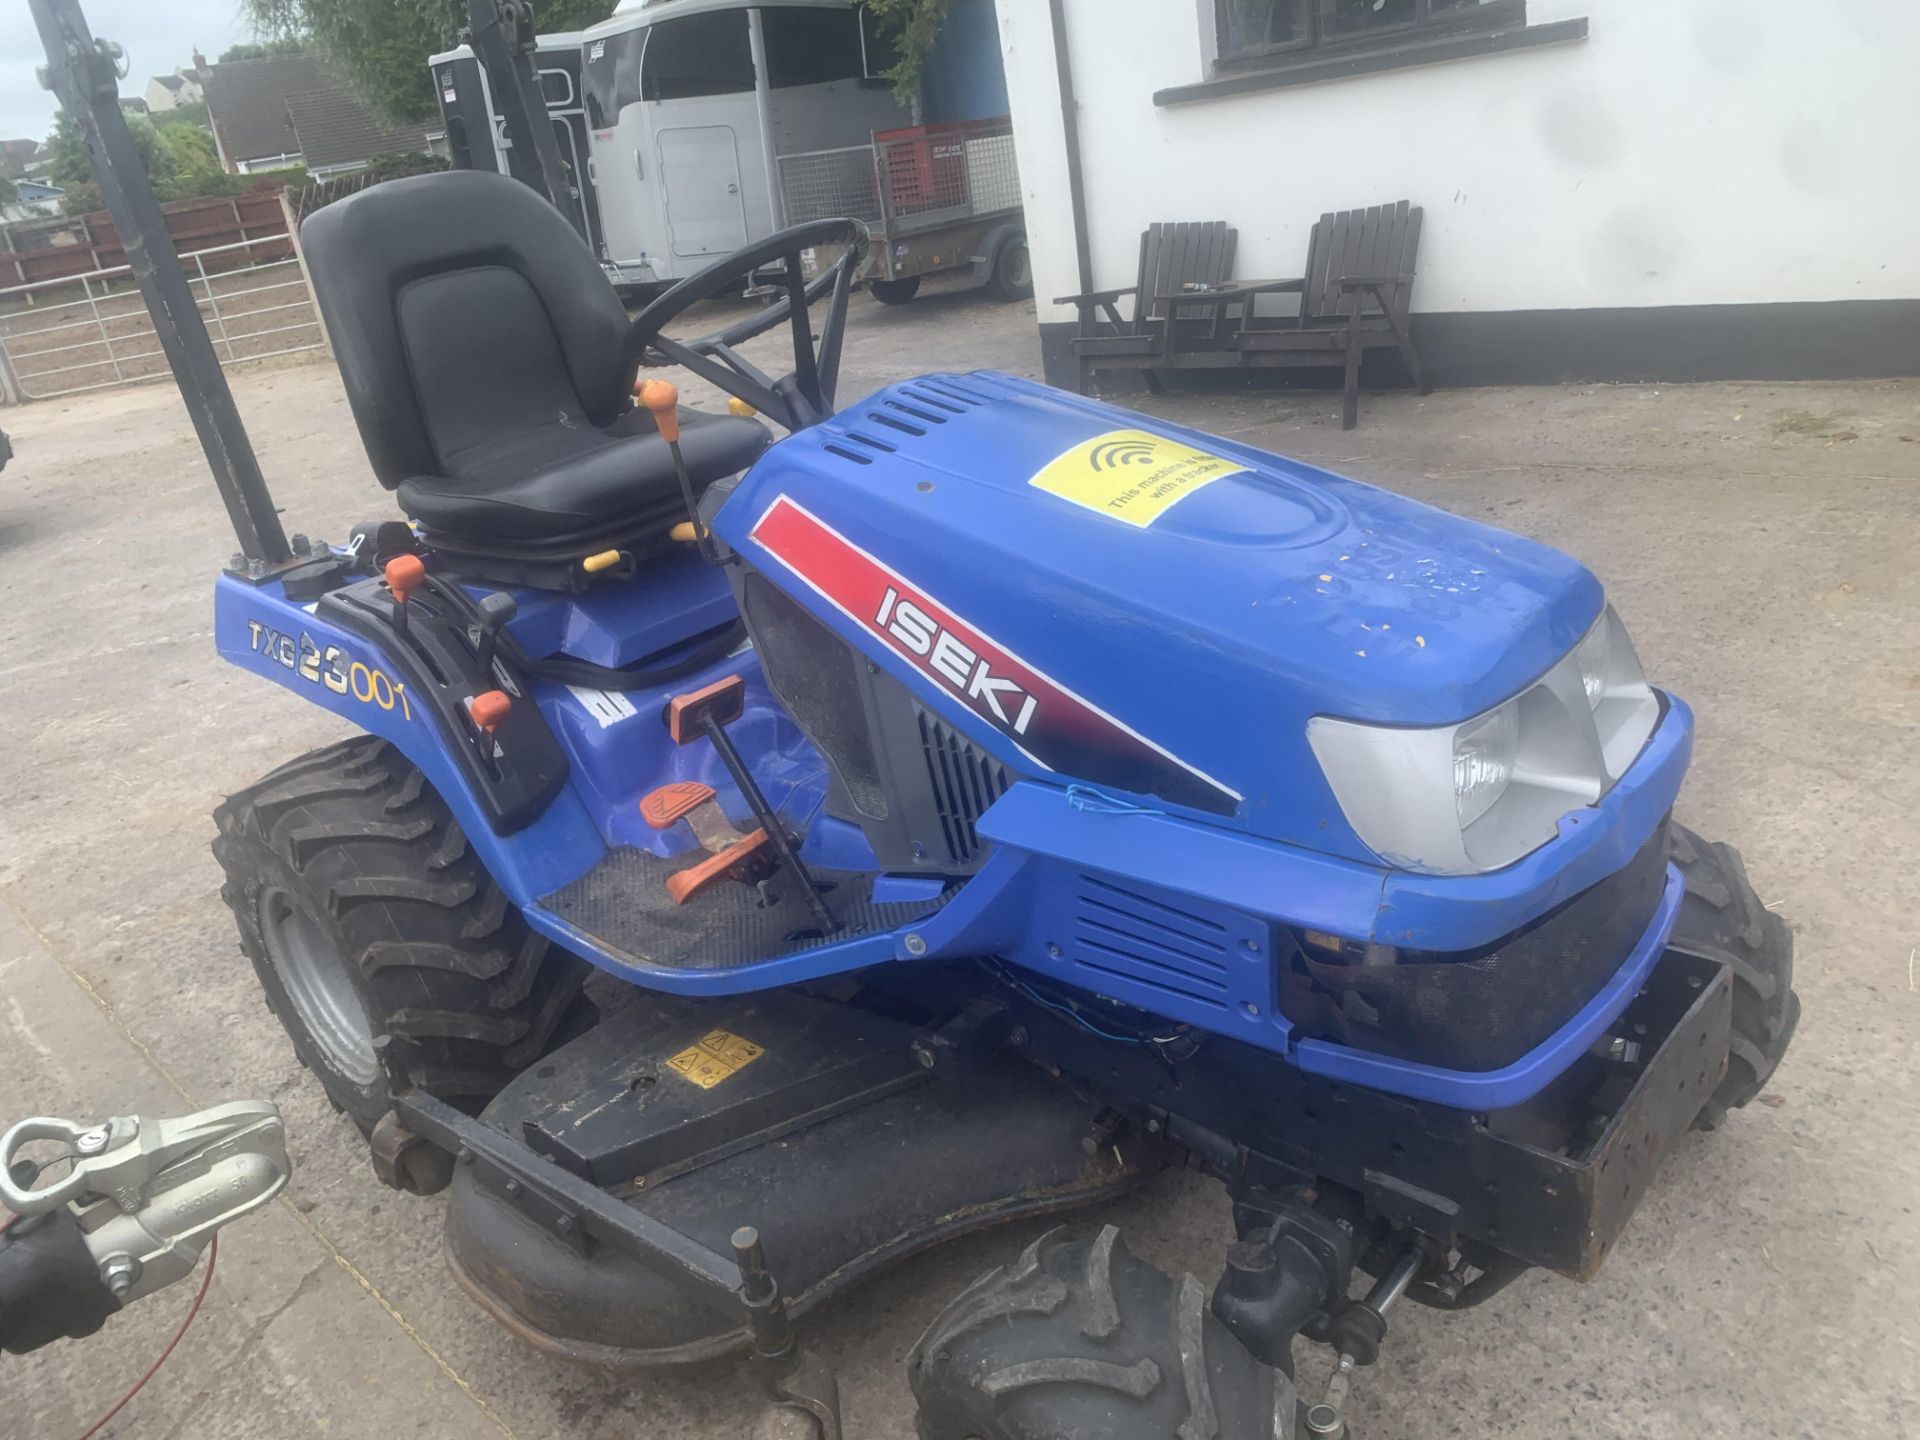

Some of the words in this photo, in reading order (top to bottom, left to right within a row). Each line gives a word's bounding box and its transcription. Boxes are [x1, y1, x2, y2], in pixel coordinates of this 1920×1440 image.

[1108, 488, 1141, 509] This
[1138, 462, 1187, 488] machine
[1149, 480, 1178, 500] with
[1175, 475, 1188, 484] a
[875, 586, 1039, 737] ISEKI
